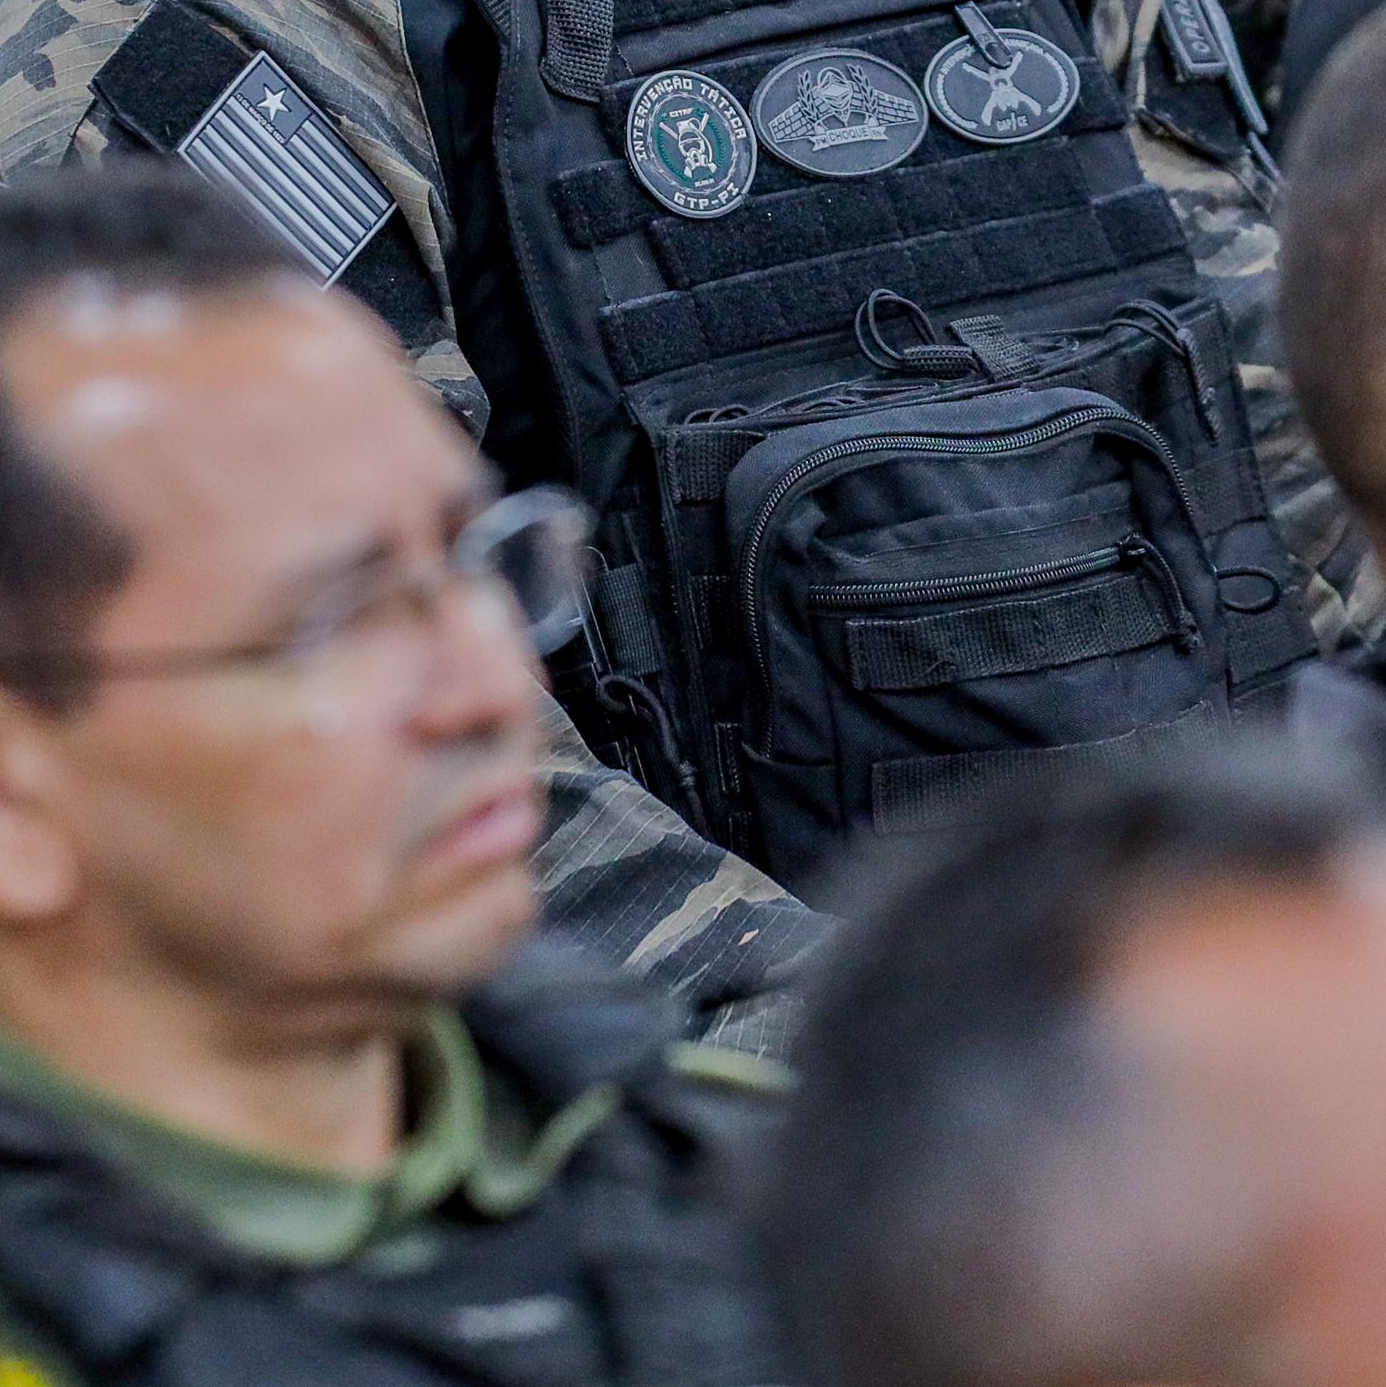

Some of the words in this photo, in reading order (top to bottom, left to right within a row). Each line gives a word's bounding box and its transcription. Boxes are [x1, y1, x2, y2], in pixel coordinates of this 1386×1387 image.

[633, 75, 694, 162] INTERVENÇÃO
[700, 83, 747, 140] TÁTICA
[829, 126, 869, 142] CHOQUE
[674, 182, 739, 210] GTP-PI
